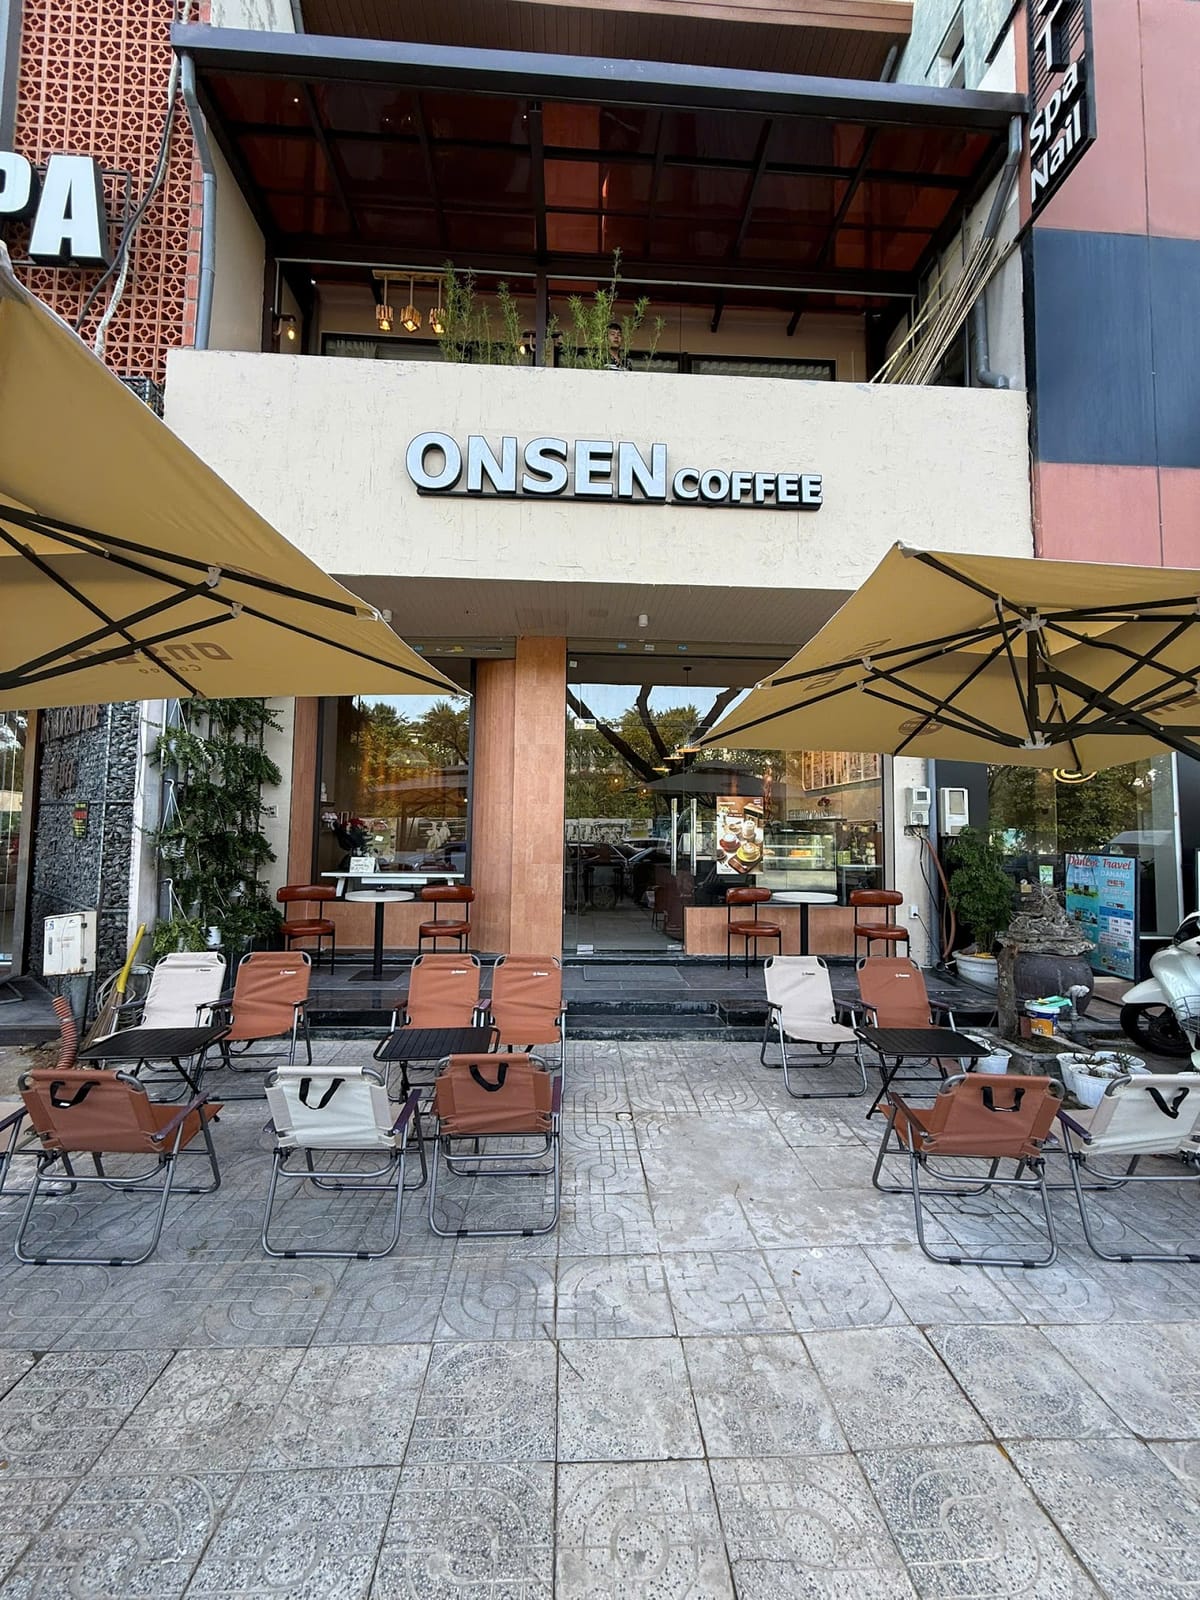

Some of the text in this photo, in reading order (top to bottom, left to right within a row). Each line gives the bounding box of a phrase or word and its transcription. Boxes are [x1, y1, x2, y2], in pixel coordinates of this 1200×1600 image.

[1030, 61, 1078, 156] Spa
[1031, 100, 1081, 203] Nail
[405, 431, 823, 505] ONSEN COFFEE
[1103, 858, 1132, 870] Travel
